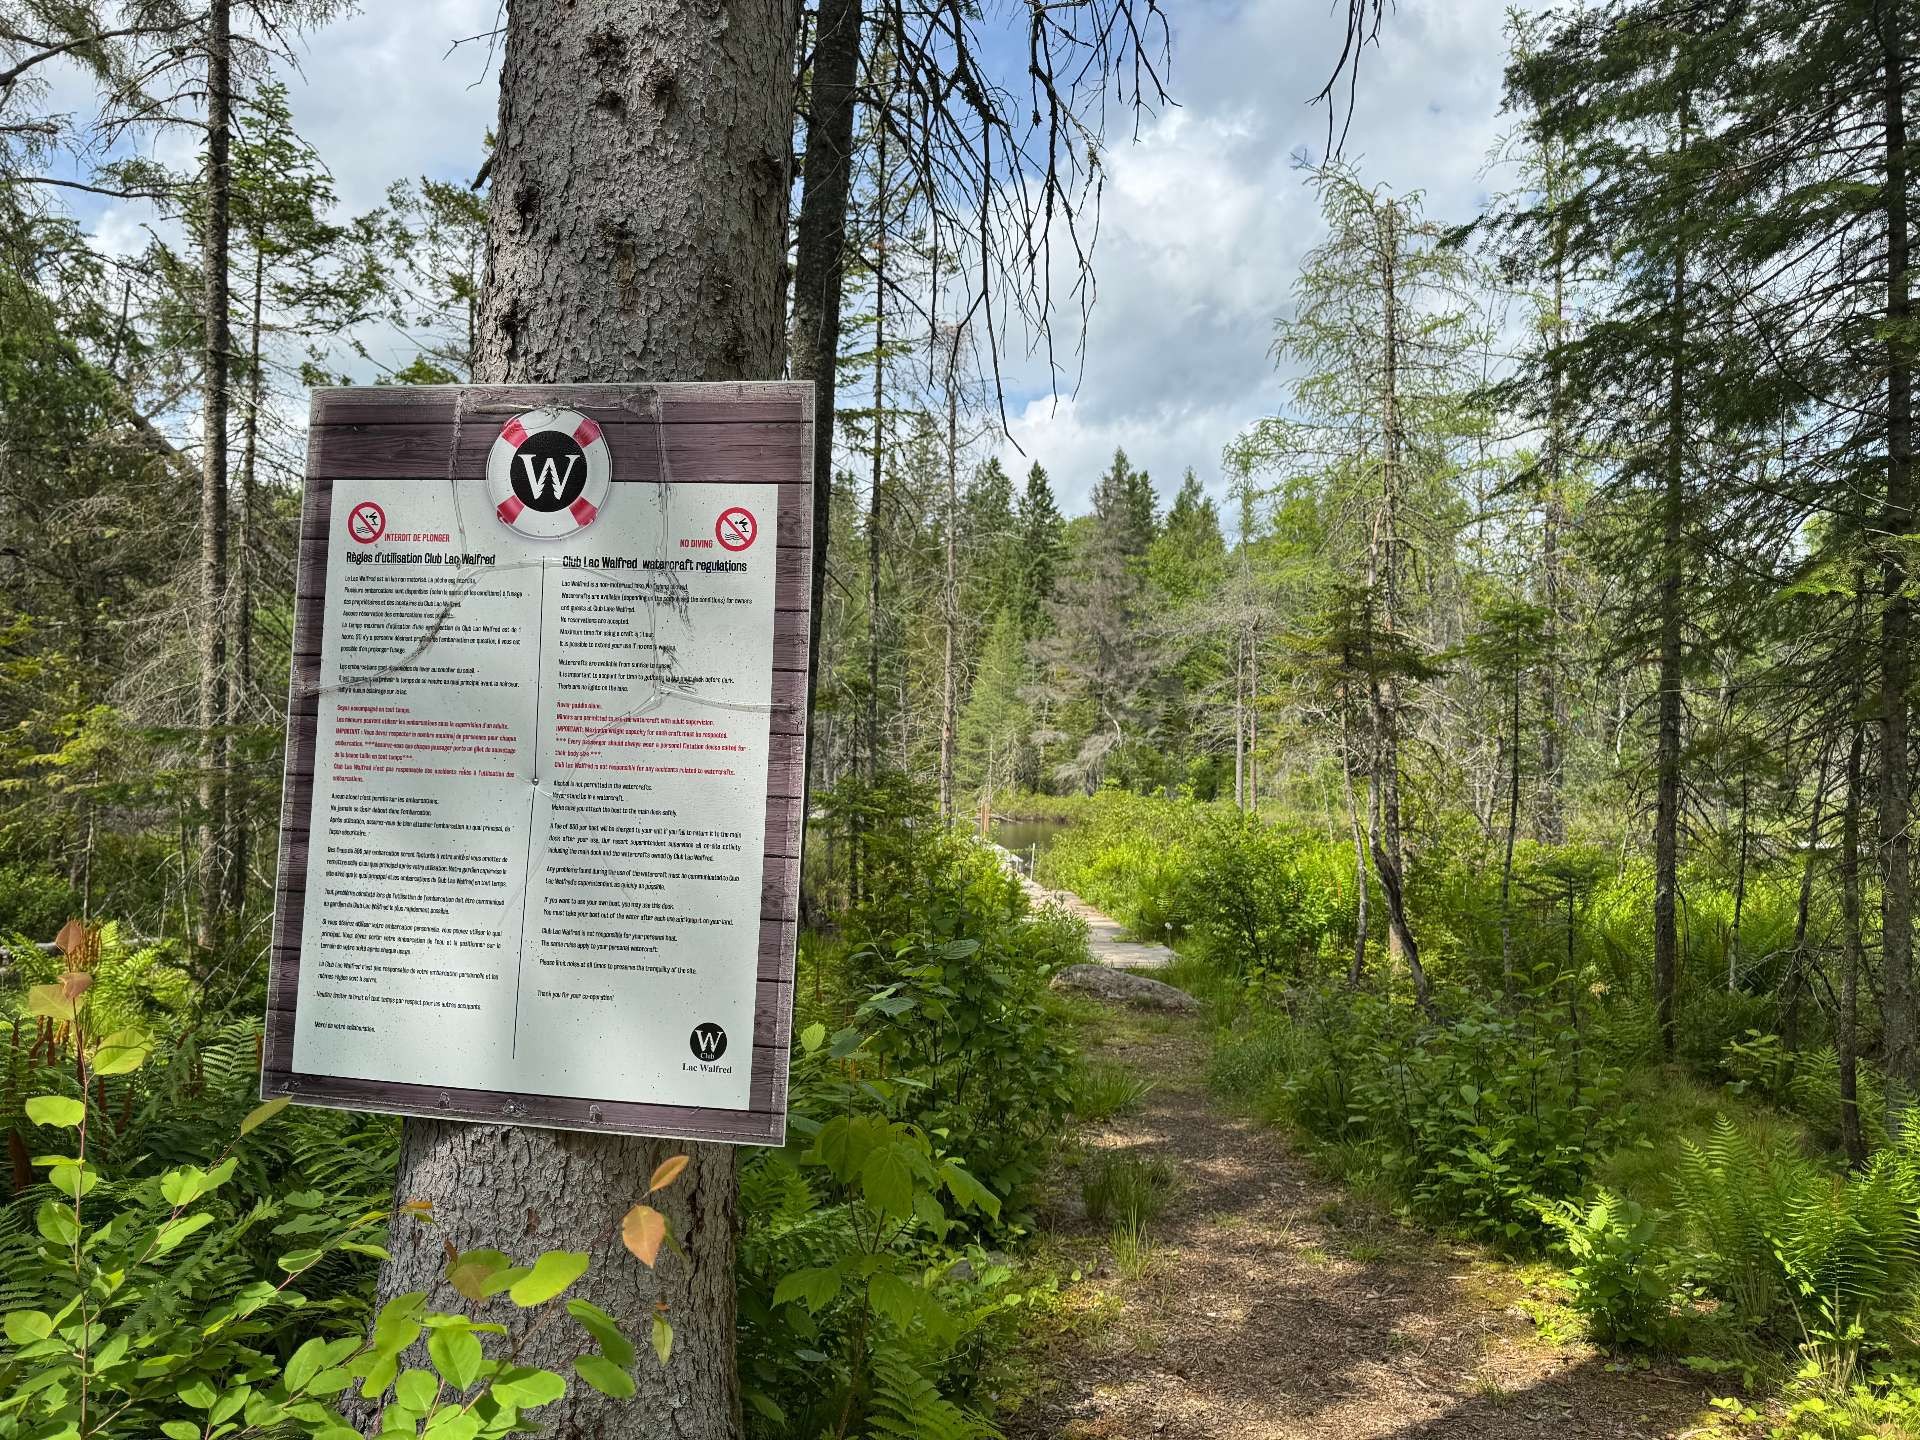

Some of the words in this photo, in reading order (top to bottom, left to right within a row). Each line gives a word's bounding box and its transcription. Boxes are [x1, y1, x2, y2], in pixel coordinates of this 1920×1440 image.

[518, 454, 581, 500] W
[384, 533, 411, 542] INTERDIT
[413, 533, 422, 542] DE
[422, 533, 450, 543] PLONGER
[680, 539, 689, 548] NO
[690, 539, 713, 549] DIVING
[346, 551, 373, 565] Règles
[374, 551, 422, 564] d'utilisation
[424, 552, 442, 564] Club
[444, 553, 460, 565] Lac
[462, 553, 496, 565] Walfred
[562, 556, 581, 568] Club
[583, 556, 600, 568] Lac
[602, 556, 638, 569] Walfred
[642, 558, 694, 571] watercraft
[695, 559, 748, 573] regulations
[694, 1029, 724, 1053] W
[700, 1052, 715, 1060] Club
[682, 1062, 698, 1072] Lac
[699, 1064, 732, 1074] Walfred
